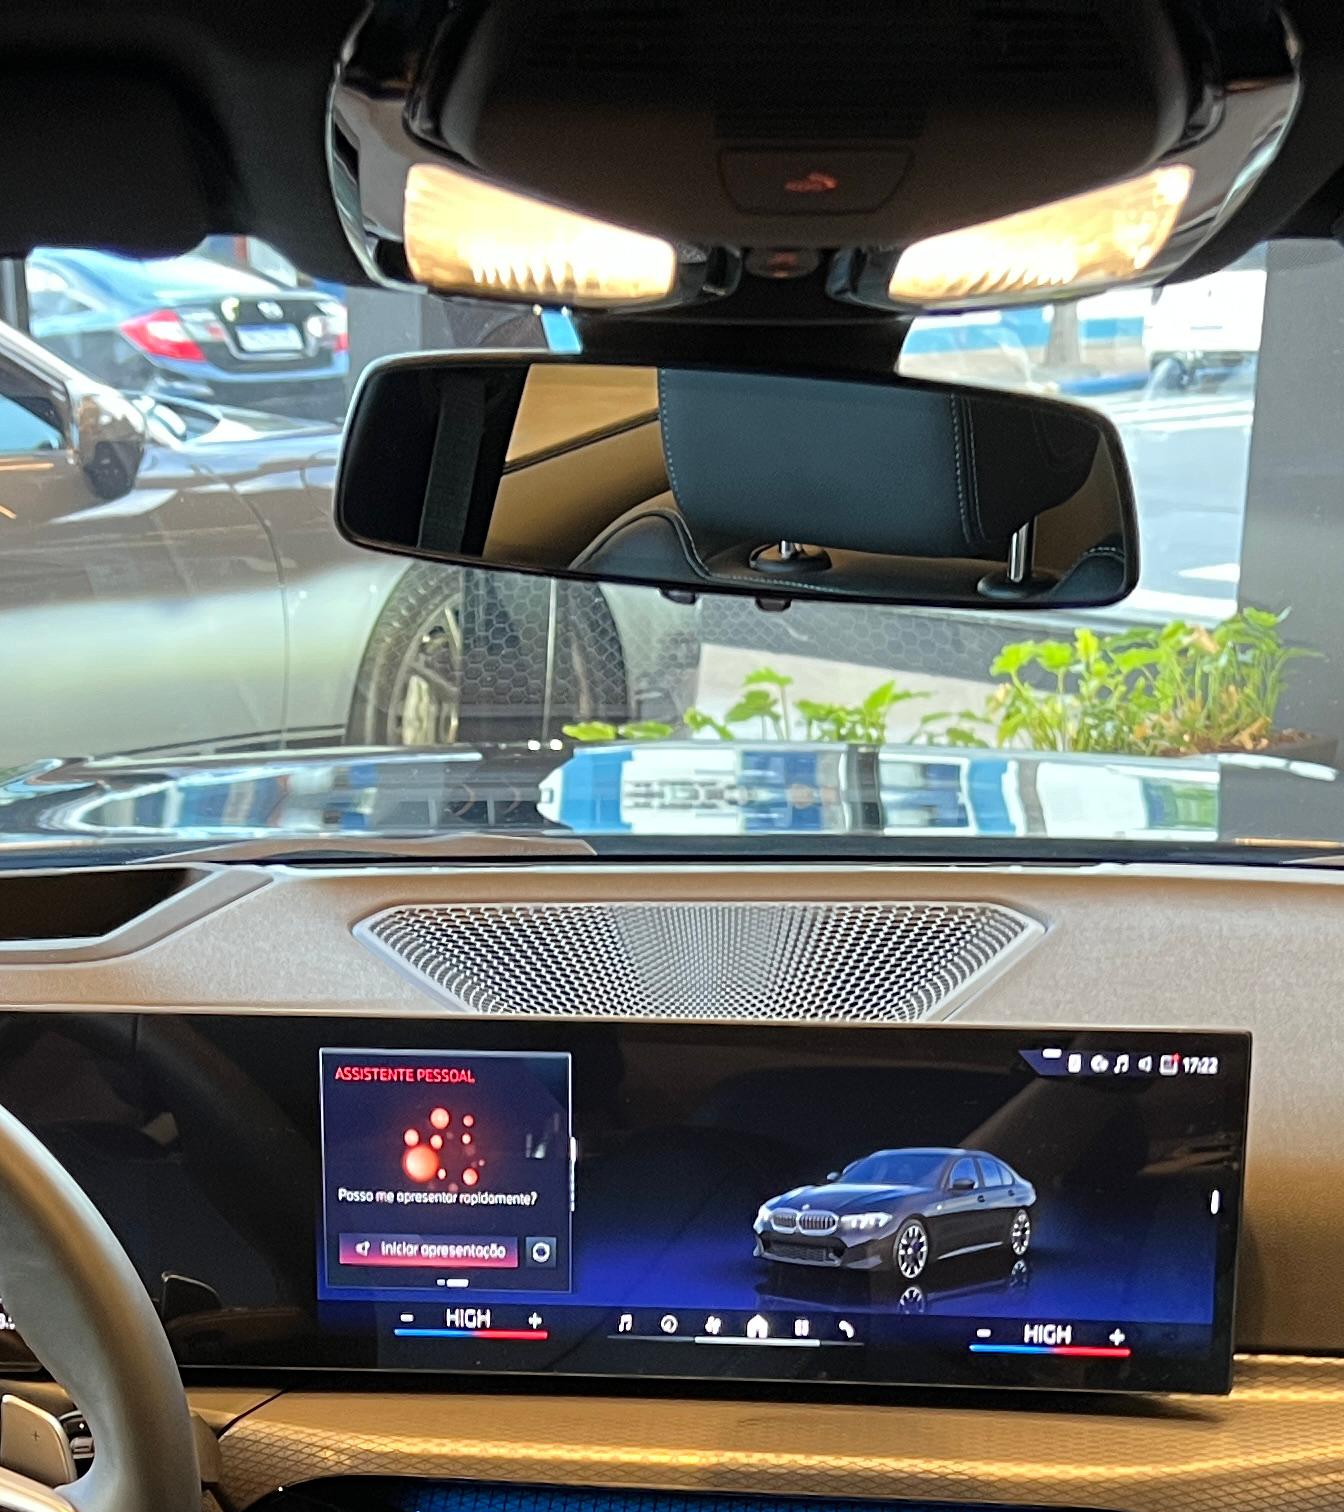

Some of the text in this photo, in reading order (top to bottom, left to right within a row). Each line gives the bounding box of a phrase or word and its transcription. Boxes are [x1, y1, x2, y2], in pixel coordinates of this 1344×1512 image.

[335, 1066, 475, 1084] ASSISTENTE PESSOAL
[1182, 1057, 1218, 1075] 17:22
[338, 1188, 538, 1207] Posso me apresentar rapidamente?
[380, 1240, 506, 1260] Iniciar apresentação
[446, 1309, 491, 1329] HIGH
[1023, 1324, 1072, 1345] HIGH
